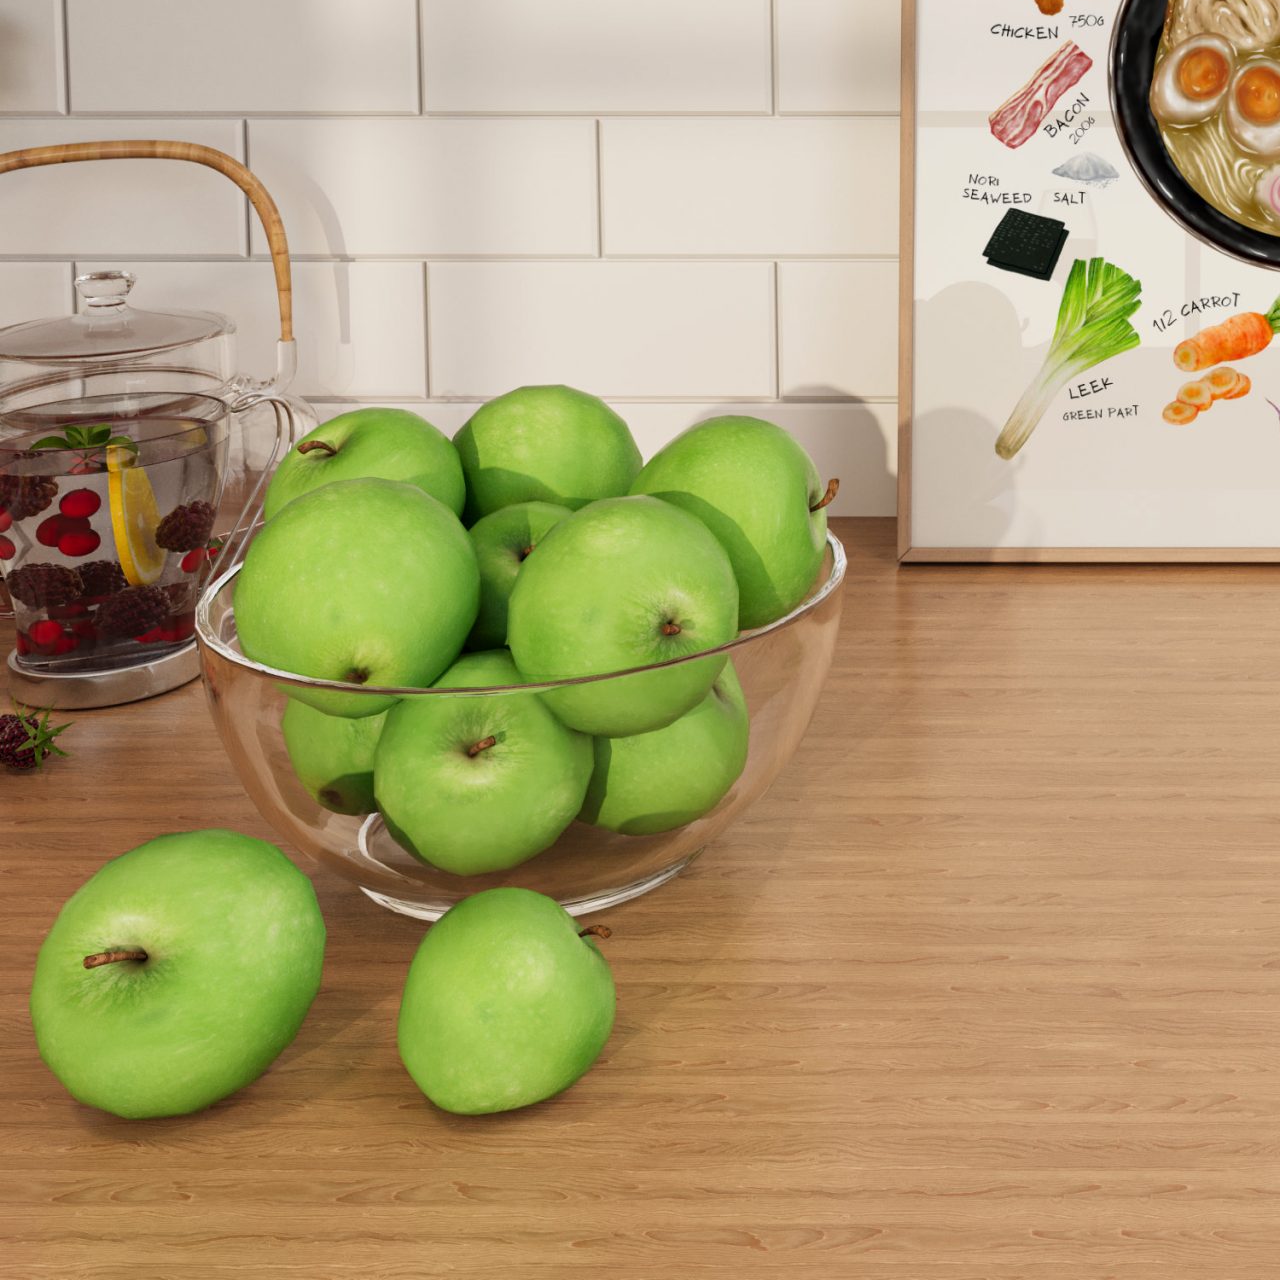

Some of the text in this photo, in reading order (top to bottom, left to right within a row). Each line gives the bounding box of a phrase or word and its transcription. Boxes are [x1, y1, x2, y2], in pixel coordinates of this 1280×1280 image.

[990, 23, 1059, 40] CHICKEN
[1043, 91, 1090, 138] BACON
[968, 173, 1000, 187] NORI
[962, 188, 1032, 205] SEAWEED
[1053, 191, 1087, 206] SALT
[1180, 292, 1241, 317] CARROT
[1068, 377, 1114, 399] LEEK
[1062, 405, 1141, 421] GREEN PART
